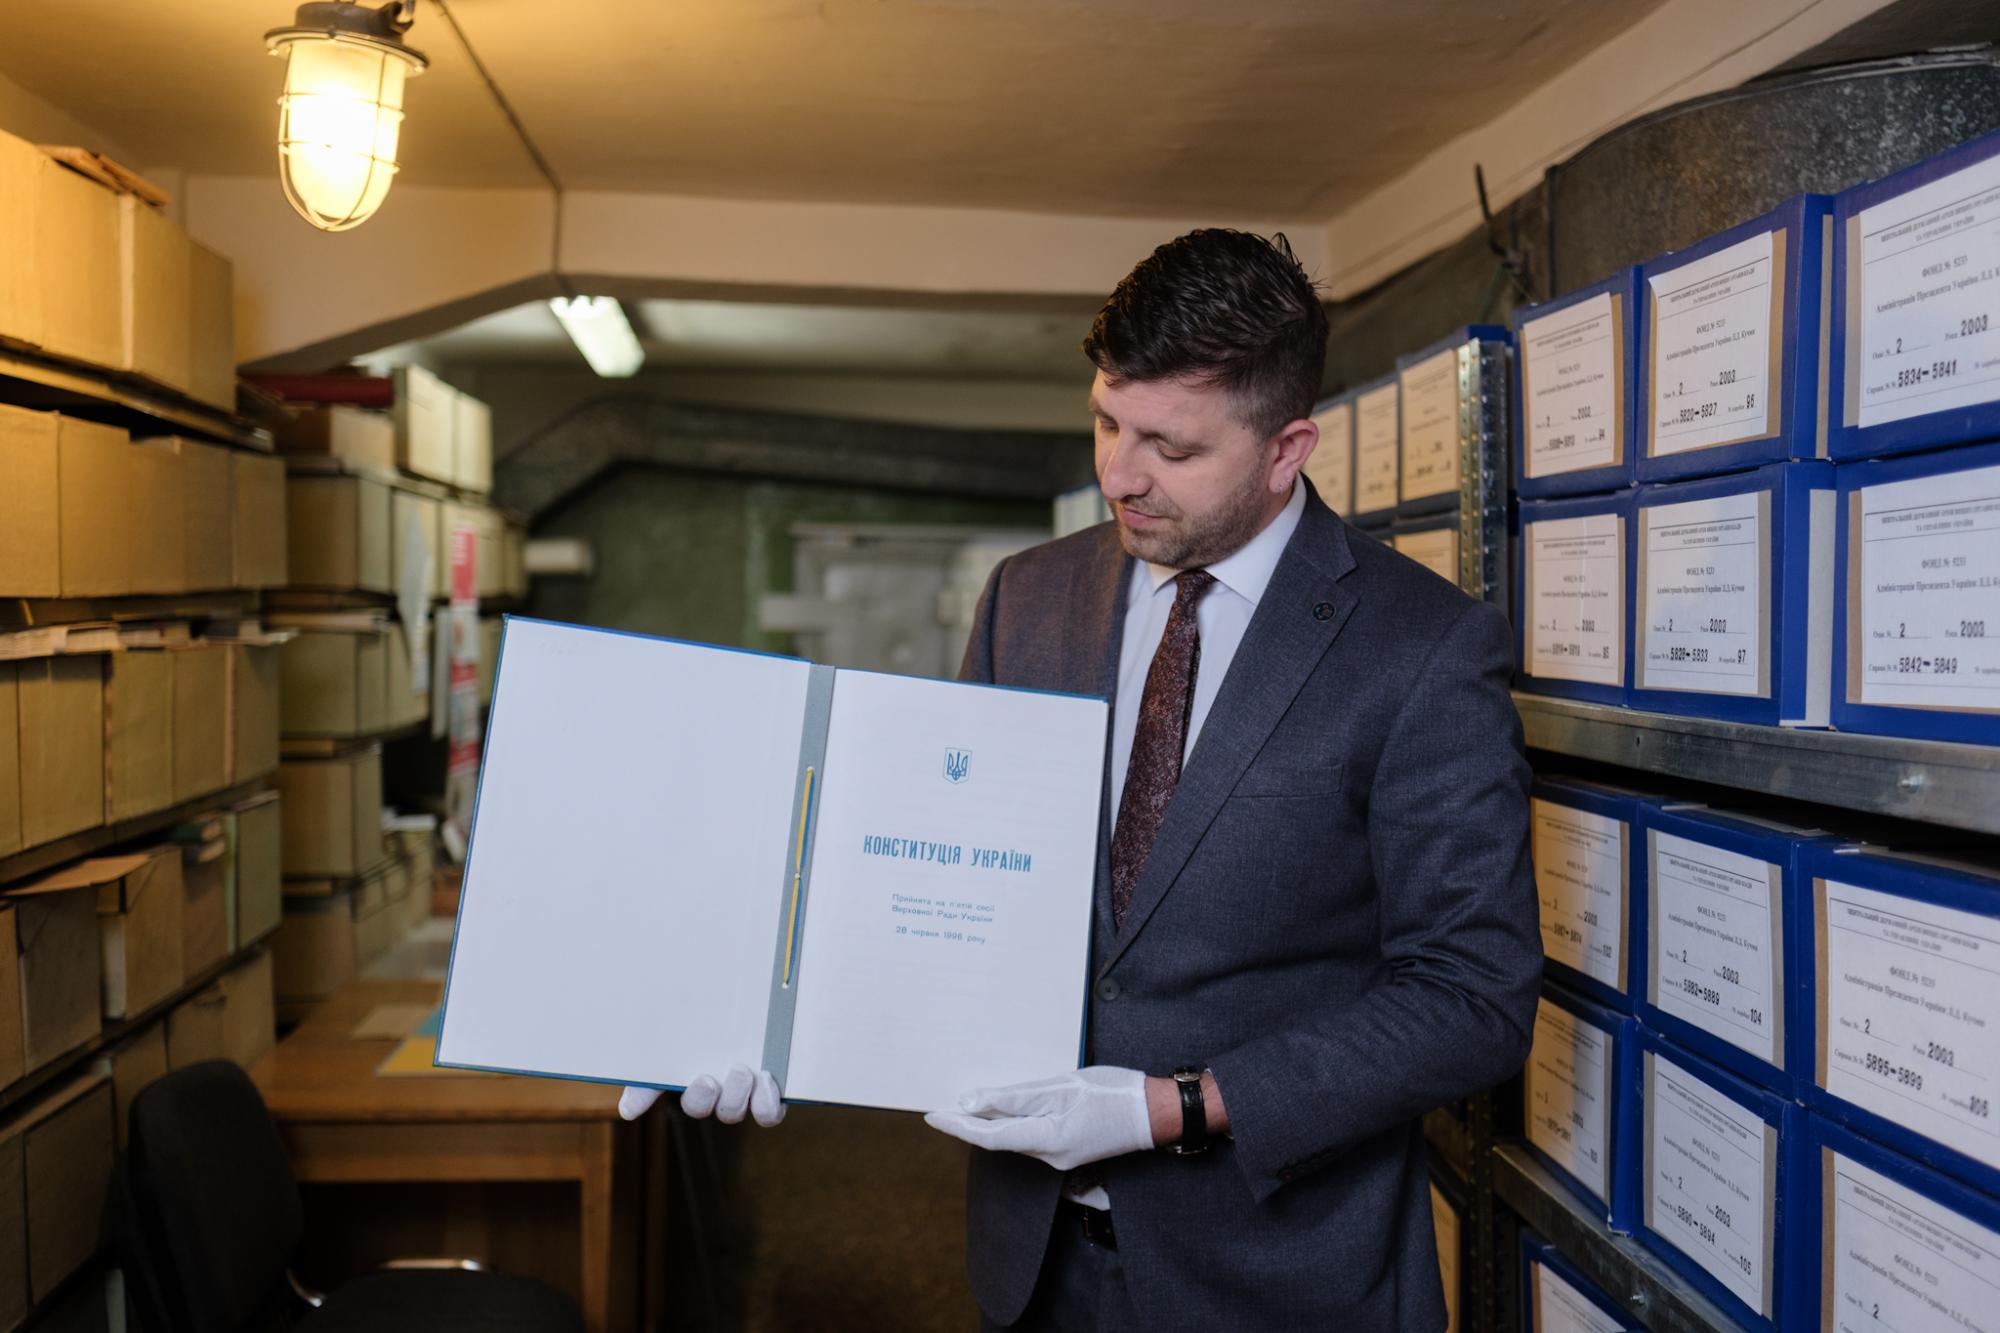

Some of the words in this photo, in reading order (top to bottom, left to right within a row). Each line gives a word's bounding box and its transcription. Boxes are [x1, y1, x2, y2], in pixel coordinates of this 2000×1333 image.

[1896, 337, 1903, 354] 2
[1679, 382, 1683, 395] 2
[1669, 618, 1673, 631] 2
[1899, 623, 1906, 638] 2
[864, 835, 961, 865] КОНСТИТУЦІЯ
[971, 847, 1032, 872] УКРАЇНИ
[892, 894, 931, 905] Прийнята
[892, 905, 932, 916] Верховної
[962, 913, 992, 922] України
[896, 926, 907, 934] 28
[944, 932, 962, 940] 1996
[1683, 949, 1687, 964] 2
[1865, 1018, 1871, 1035] 2
[1678, 1175, 1683, 1191] 2
[1873, 1304, 1879, 1319] 2
